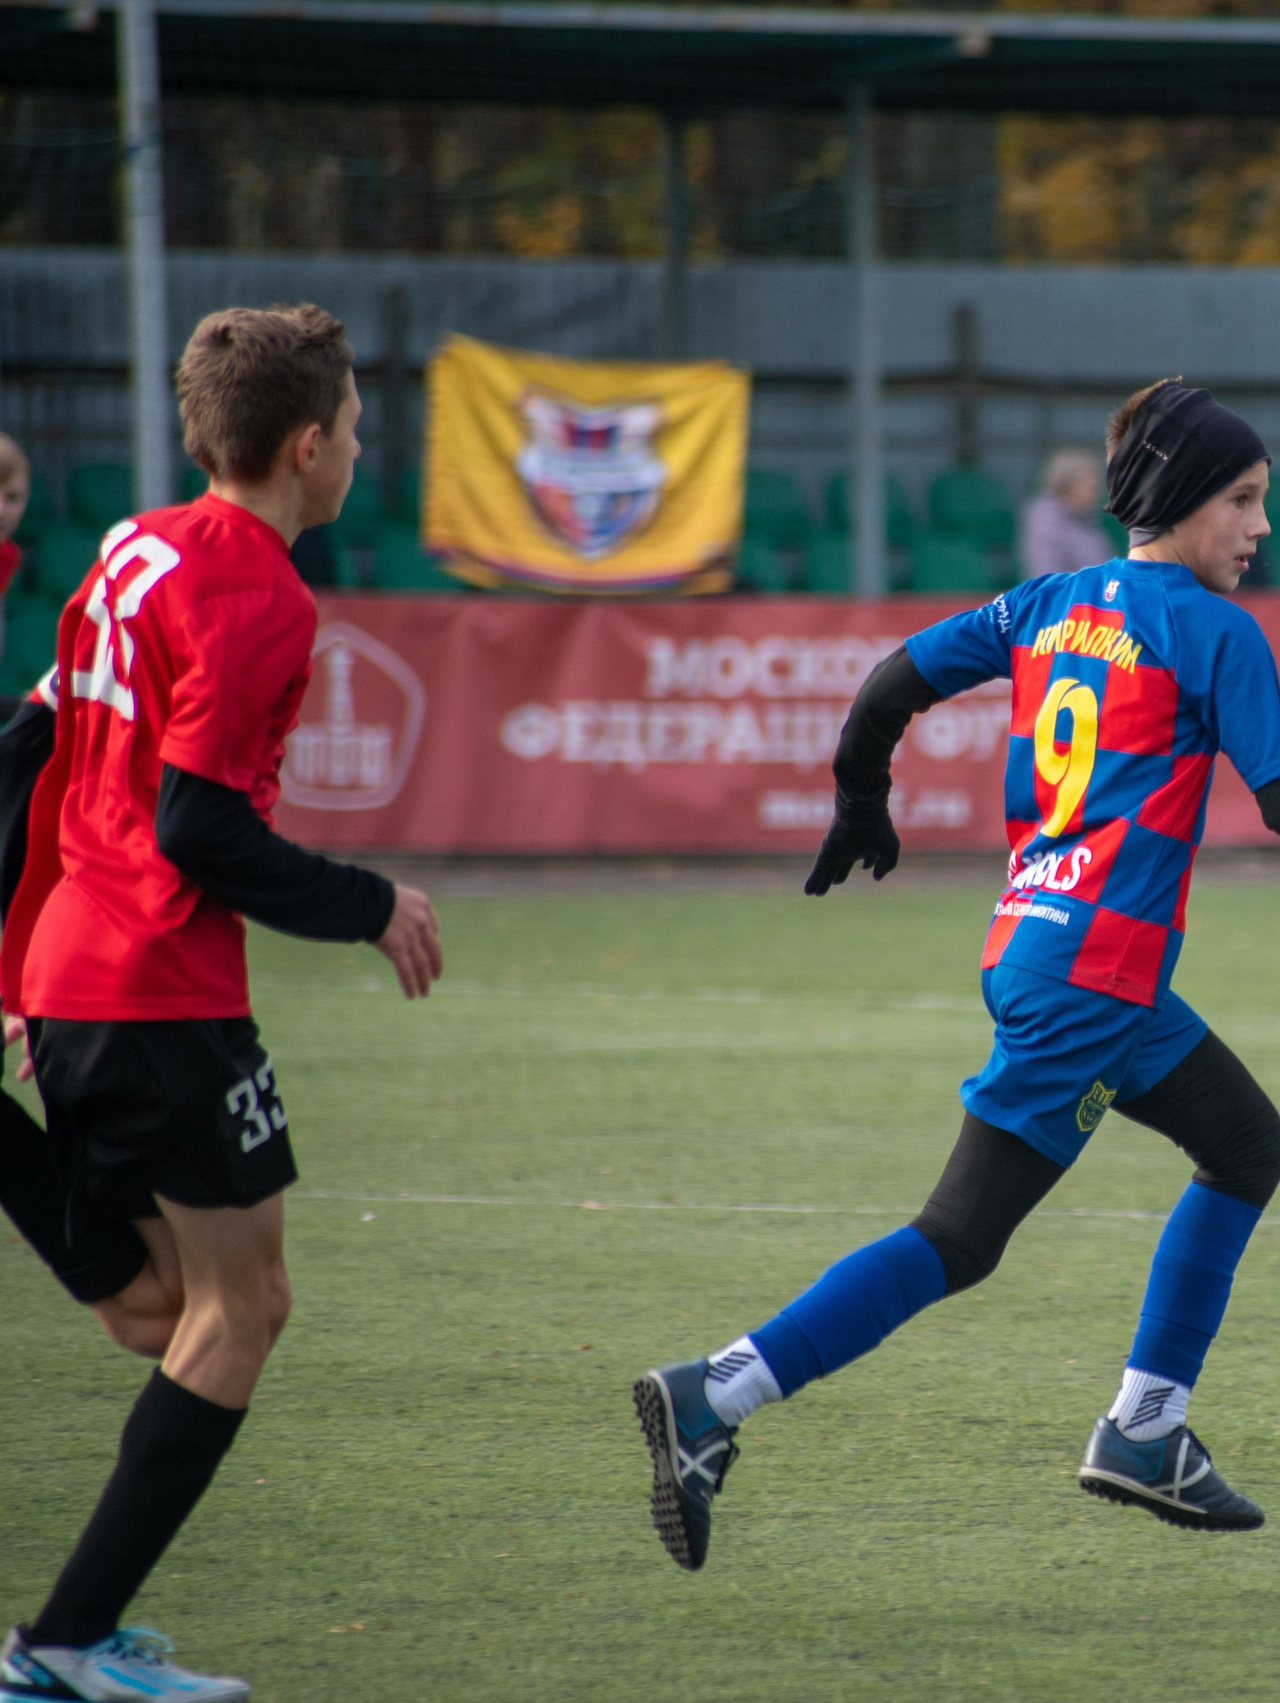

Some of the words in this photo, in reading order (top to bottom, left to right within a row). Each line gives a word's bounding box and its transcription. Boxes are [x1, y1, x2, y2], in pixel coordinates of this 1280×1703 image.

[502, 703, 848, 772] ФЕДЕРАЦИ
[1034, 678, 1098, 838] 9
[226, 1057, 288, 1153] 33
